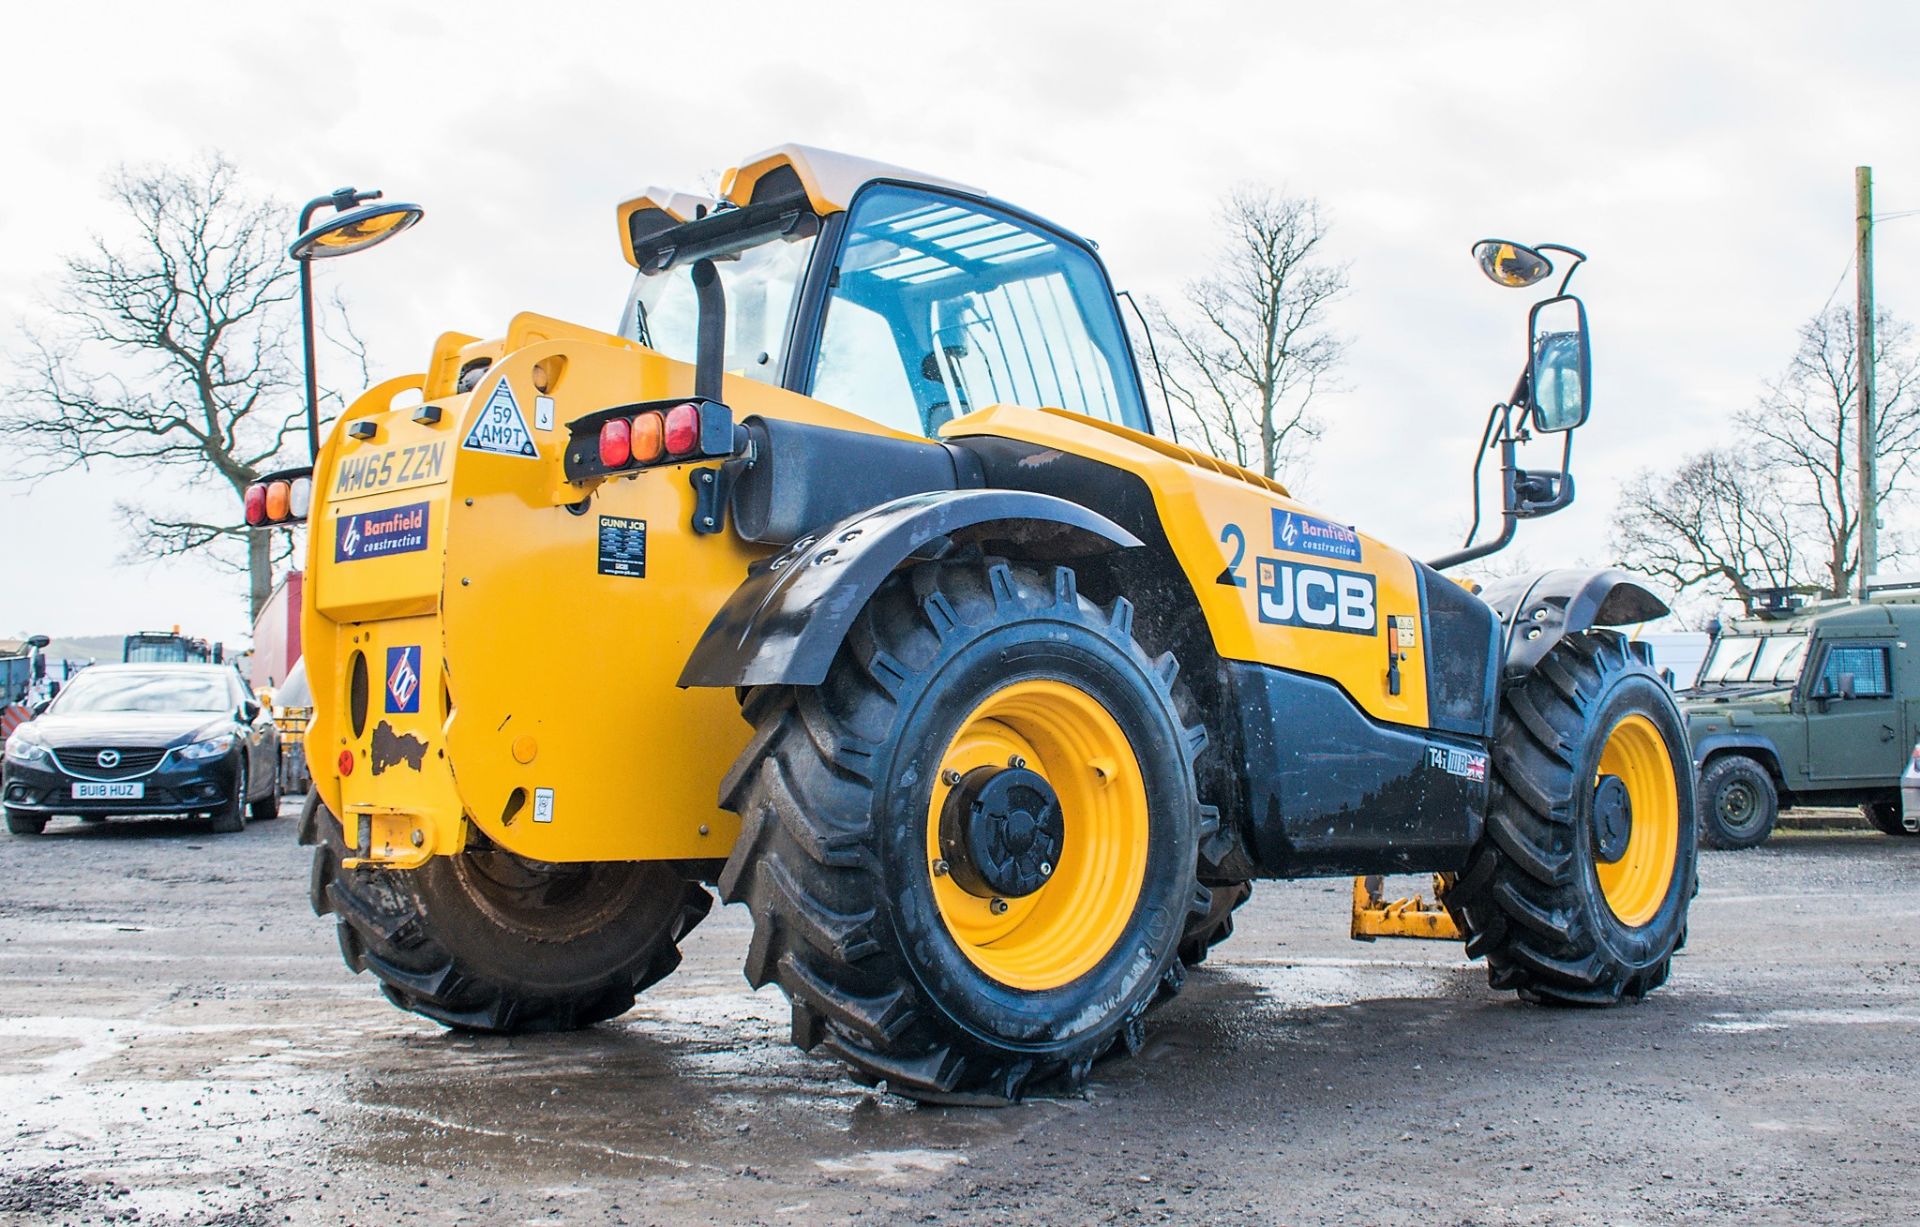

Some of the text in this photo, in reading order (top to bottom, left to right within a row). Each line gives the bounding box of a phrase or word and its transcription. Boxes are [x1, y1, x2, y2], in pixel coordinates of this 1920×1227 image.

[493, 405, 512, 425] 59
[481, 424, 522, 447] AM9T
[336, 441, 447, 495] MM65 ZZN
[364, 509, 422, 537] Barnfield
[601, 518, 645, 530] GUNN JCB
[1301, 520, 1355, 543] Barnfield
[363, 533, 421, 553] construction
[1302, 541, 1356, 557] construction
[1216, 523, 1247, 588] 2
[1260, 566, 1375, 631] JCB
[1429, 747, 1447, 770] T4i
[79, 785, 134, 797] BU18 HUZ
